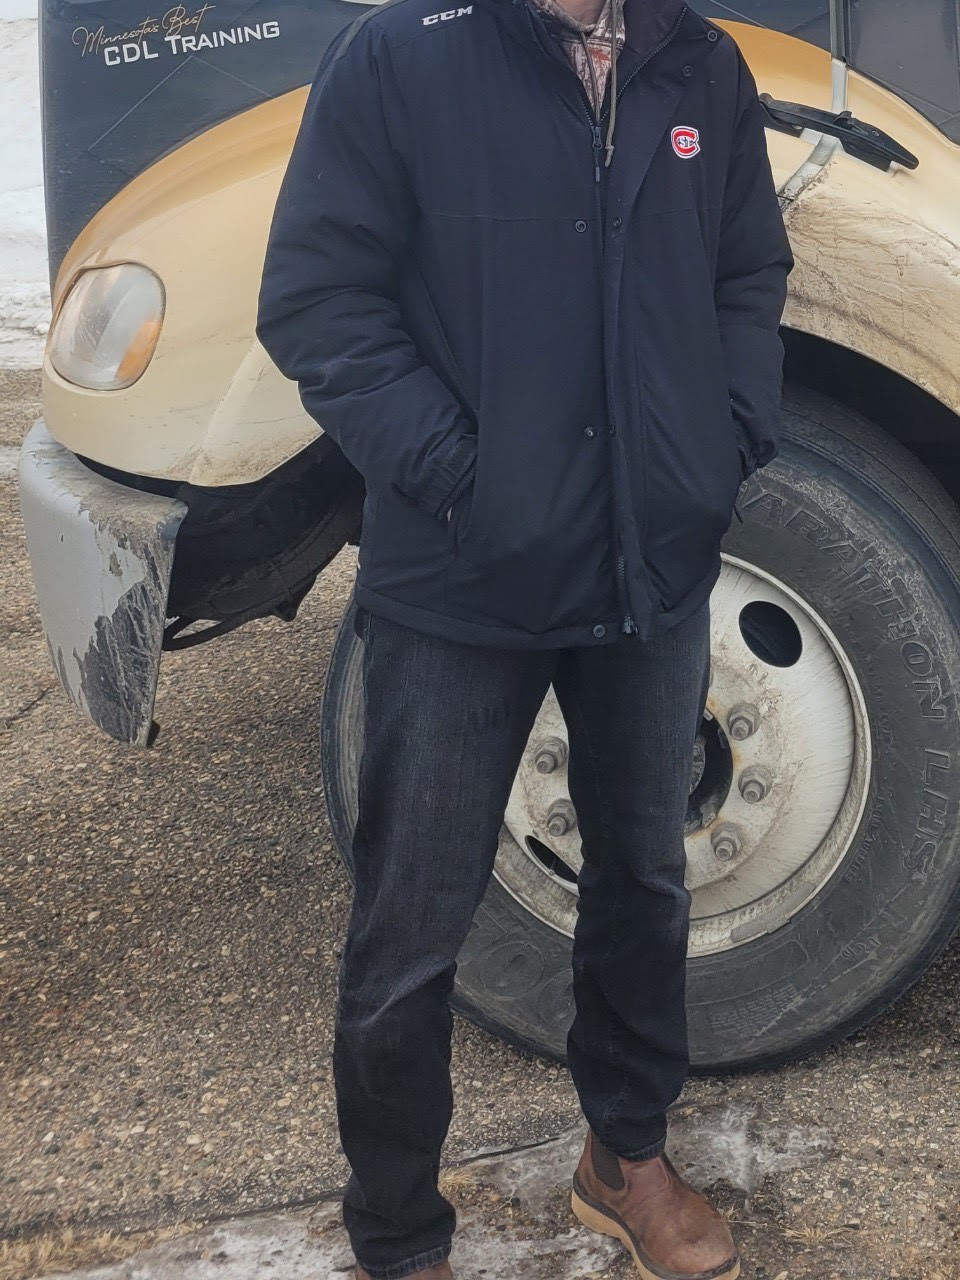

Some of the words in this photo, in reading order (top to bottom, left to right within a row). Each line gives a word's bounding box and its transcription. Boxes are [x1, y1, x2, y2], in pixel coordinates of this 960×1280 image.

[161, 2, 217, 38] Best
[421, 4, 473, 26] CCM
[103, 40, 159, 67] CDL
[164, 21, 280, 55] TRAINING
